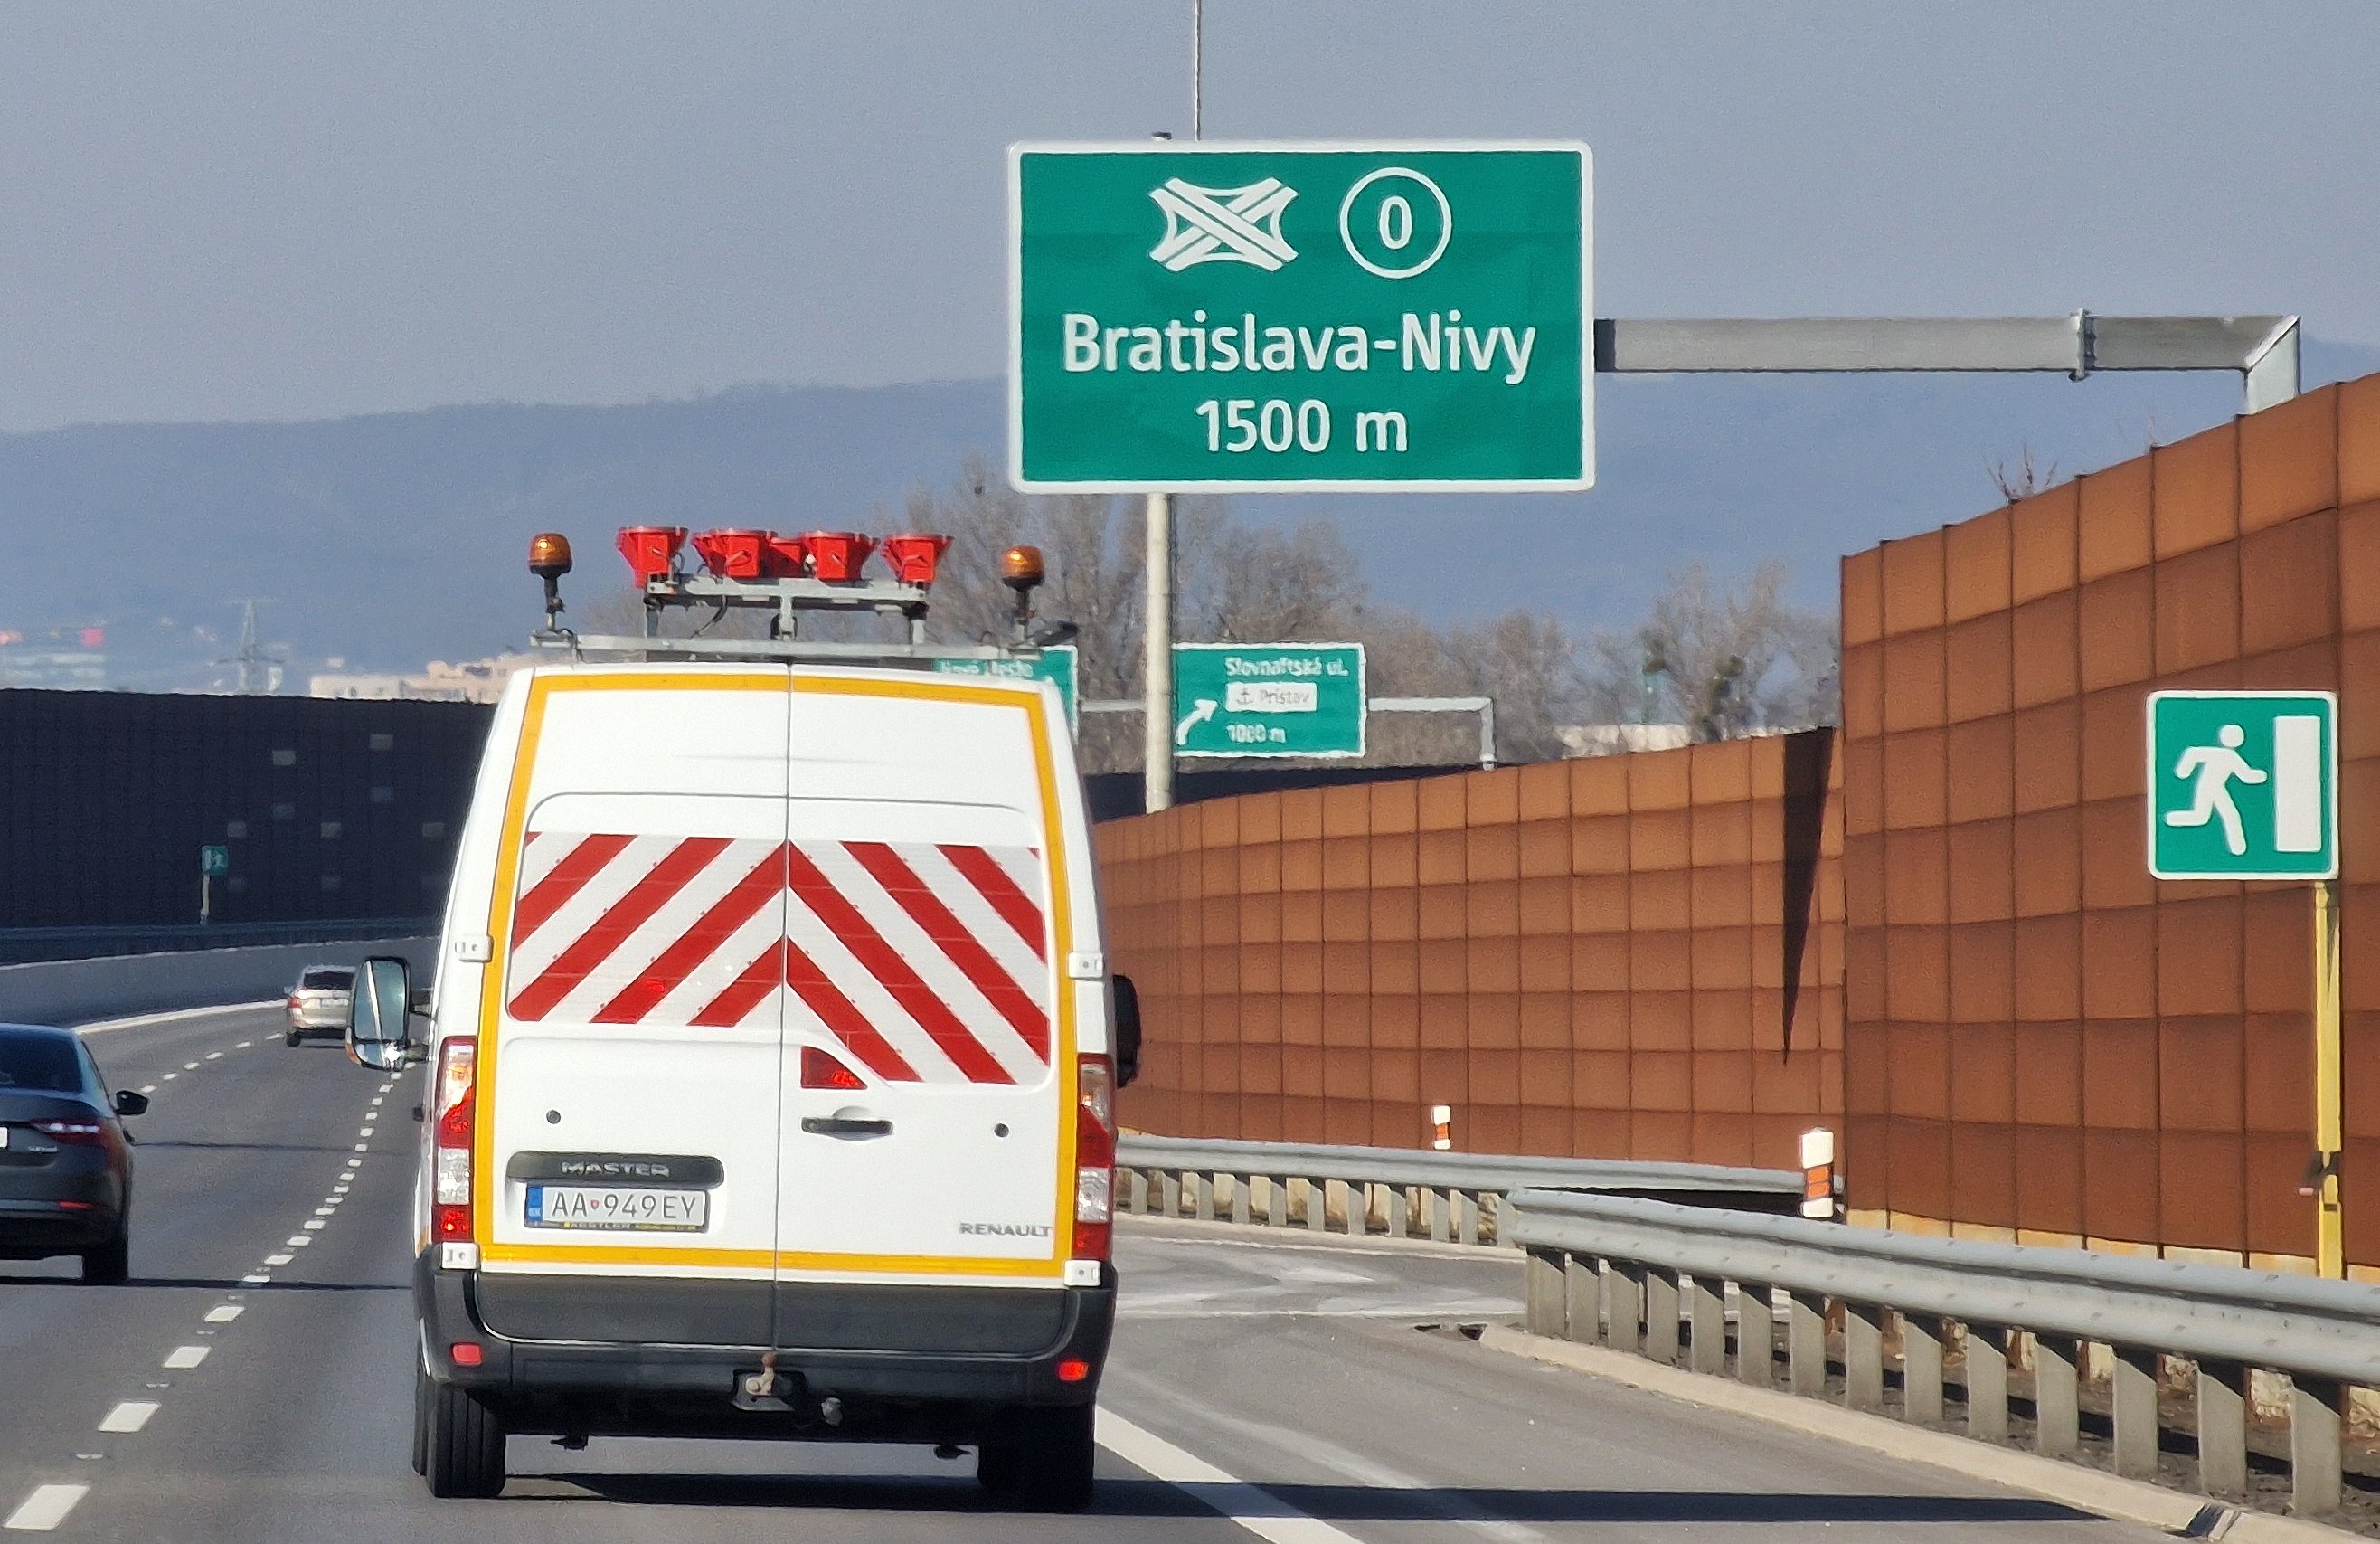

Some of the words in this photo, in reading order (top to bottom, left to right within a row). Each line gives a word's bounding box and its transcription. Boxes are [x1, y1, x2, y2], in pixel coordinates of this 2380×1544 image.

[1378, 196, 1412, 250] 0
[1063, 309, 1536, 385] Bratislava-Nivy
[1195, 400, 1331, 453] 1500
[1356, 411, 1408, 452] m
[1269, 728, 1286, 743] m
[561, 1161, 669, 1177] MASTER
[959, 1222, 1052, 1237] RENAULT
